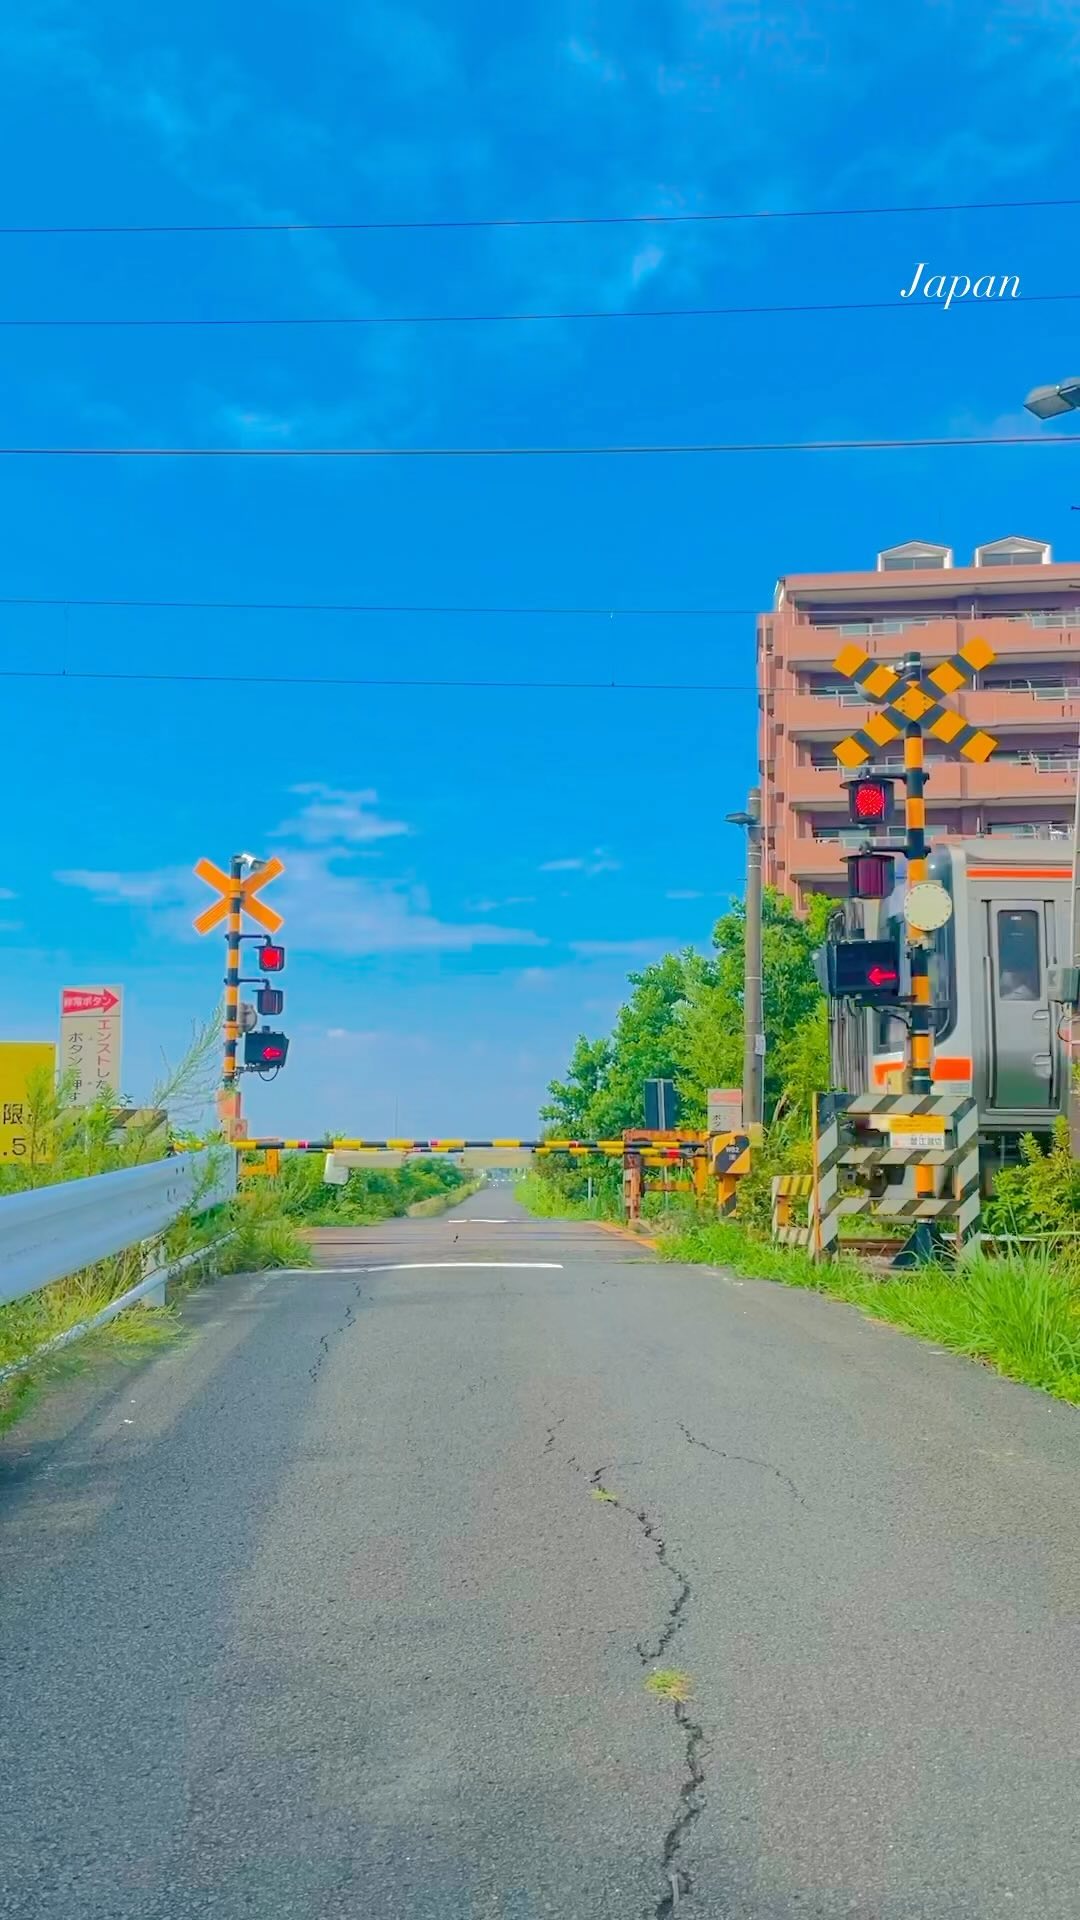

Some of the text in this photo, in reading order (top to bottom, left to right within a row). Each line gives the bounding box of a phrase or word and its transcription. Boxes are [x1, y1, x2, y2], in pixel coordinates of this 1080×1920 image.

[96, 1019, 112, 1096] エンストした
